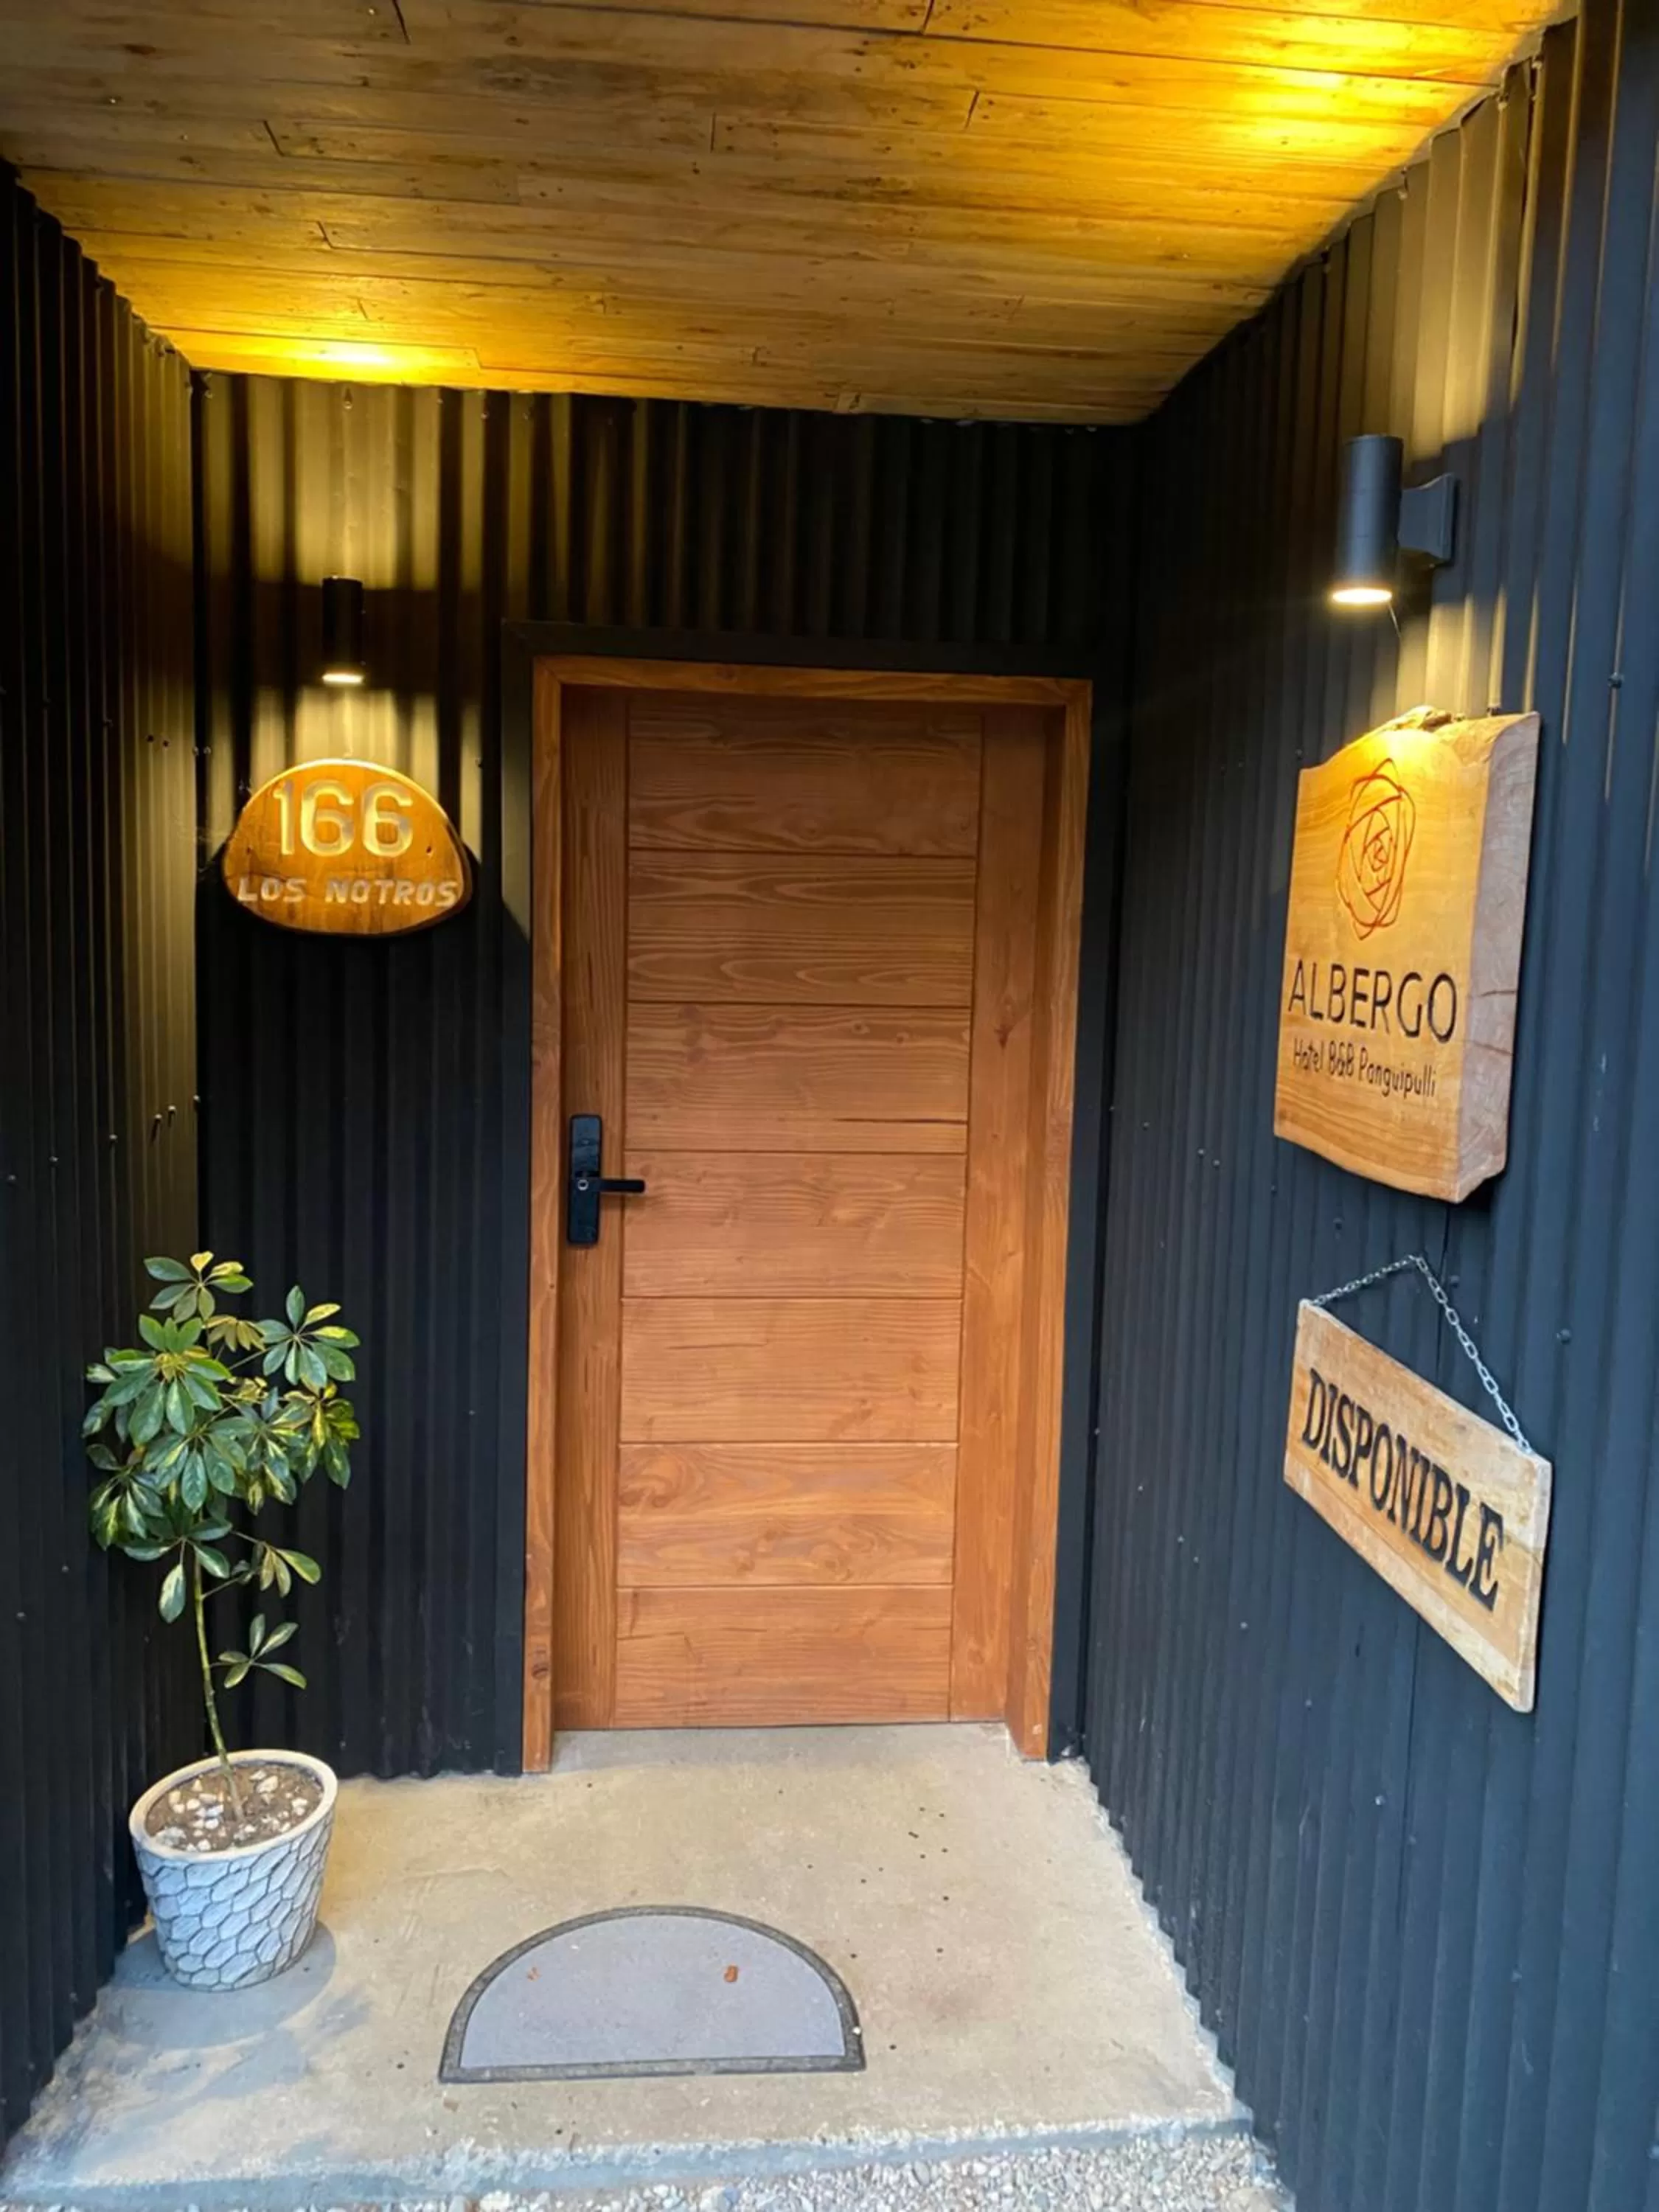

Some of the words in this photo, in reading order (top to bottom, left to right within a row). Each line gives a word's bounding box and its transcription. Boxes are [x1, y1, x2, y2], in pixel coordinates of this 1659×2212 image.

[273, 779, 414, 857] 166
[237, 877, 307, 902] LOS
[324, 877, 459, 908] NOTROS
[1288, 959, 1457, 1044] ALBERGO
[1293, 1037, 1324, 1074] Hotel
[1358, 1046, 1437, 1099] Panguipulli
[1301, 1368, 1504, 1612] DISPONIBLE
